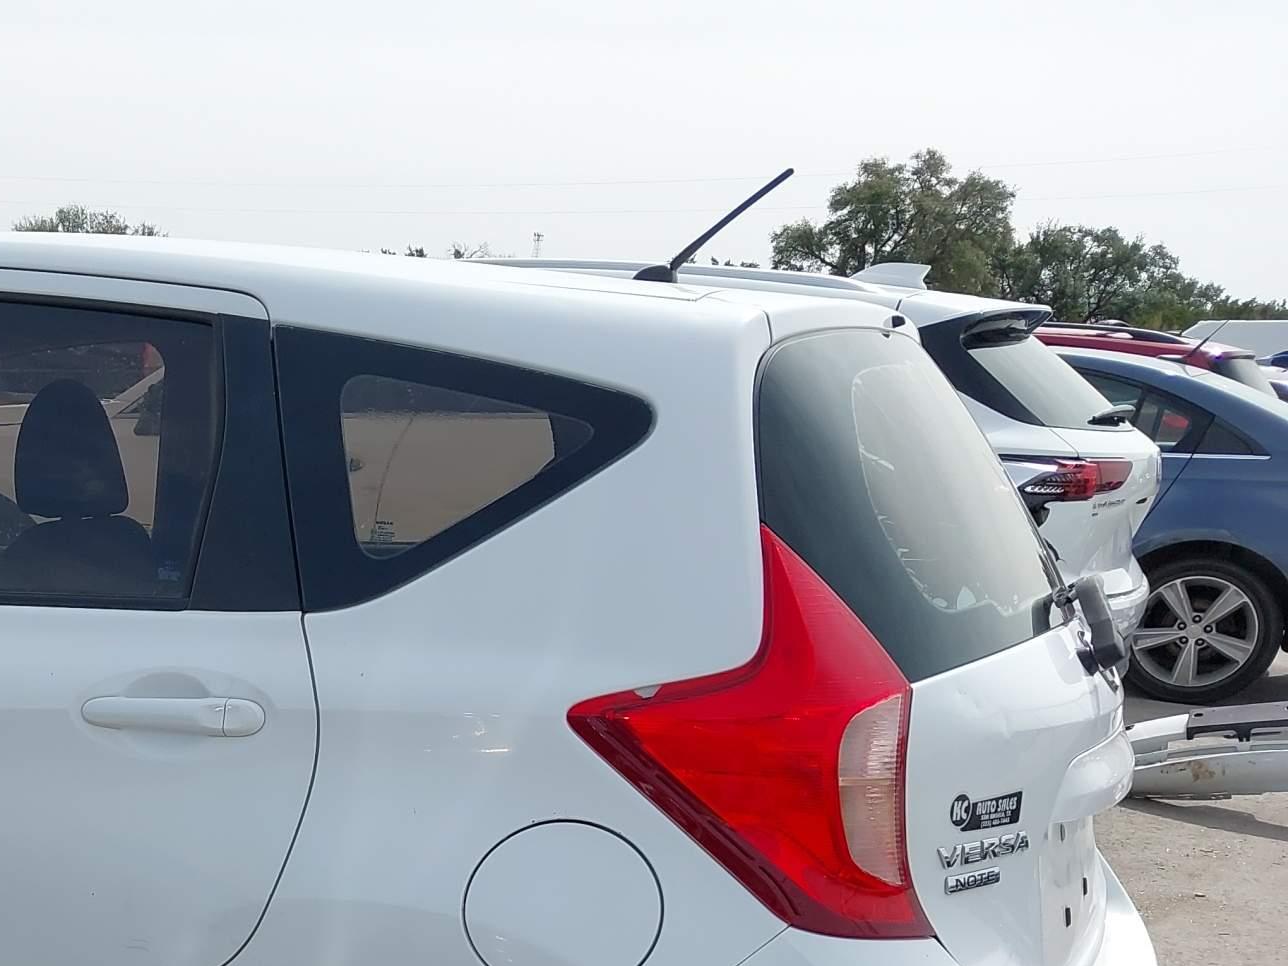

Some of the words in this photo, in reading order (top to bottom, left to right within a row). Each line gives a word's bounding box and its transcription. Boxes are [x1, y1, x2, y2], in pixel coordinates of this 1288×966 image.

[976, 800, 997, 815] AUTO
[997, 797, 1017, 812] SALES
[937, 831, 1029, 869] VERSA
[955, 870, 996, 889] NOTE
